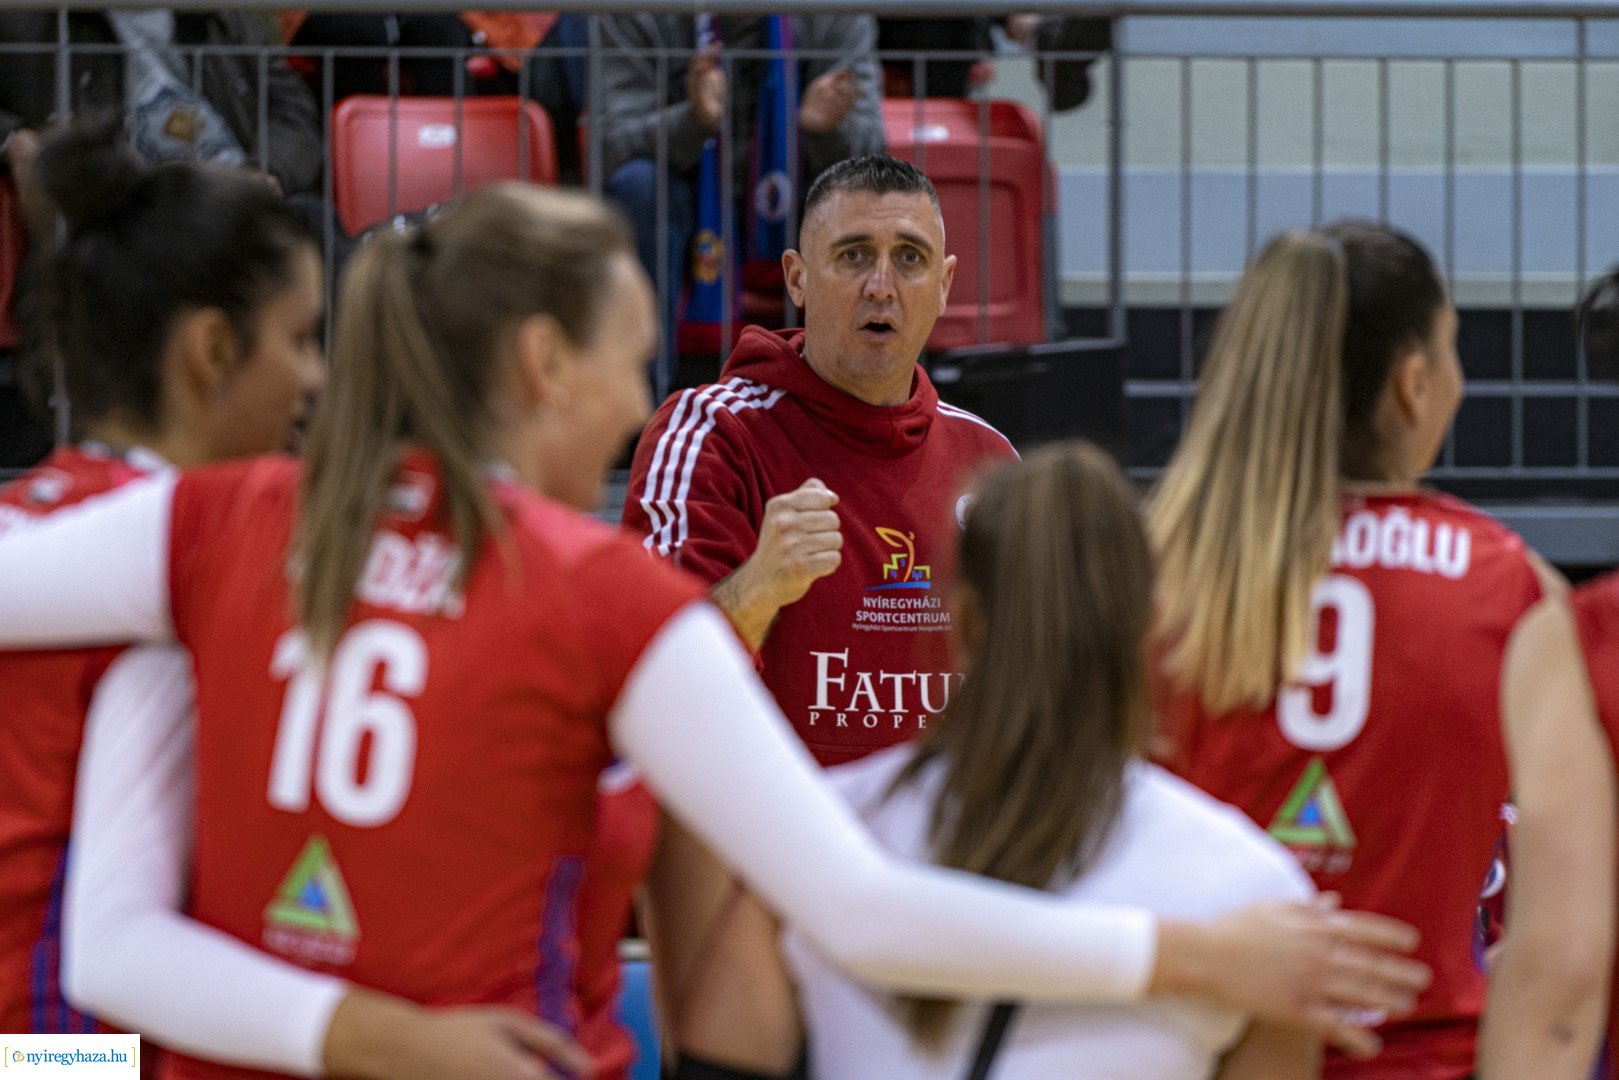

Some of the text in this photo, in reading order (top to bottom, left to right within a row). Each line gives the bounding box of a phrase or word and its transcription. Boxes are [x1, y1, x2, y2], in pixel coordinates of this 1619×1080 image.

[1331, 505, 1471, 580] OĞLU
[855, 610, 951, 623] SPORTCENTRUM
[863, 596, 941, 609] NYÍREGYHÁZI
[808, 648, 967, 713] FATU
[1276, 573, 1376, 752] 9
[267, 616, 430, 828] 16
[809, 712, 947, 729] PROPE
